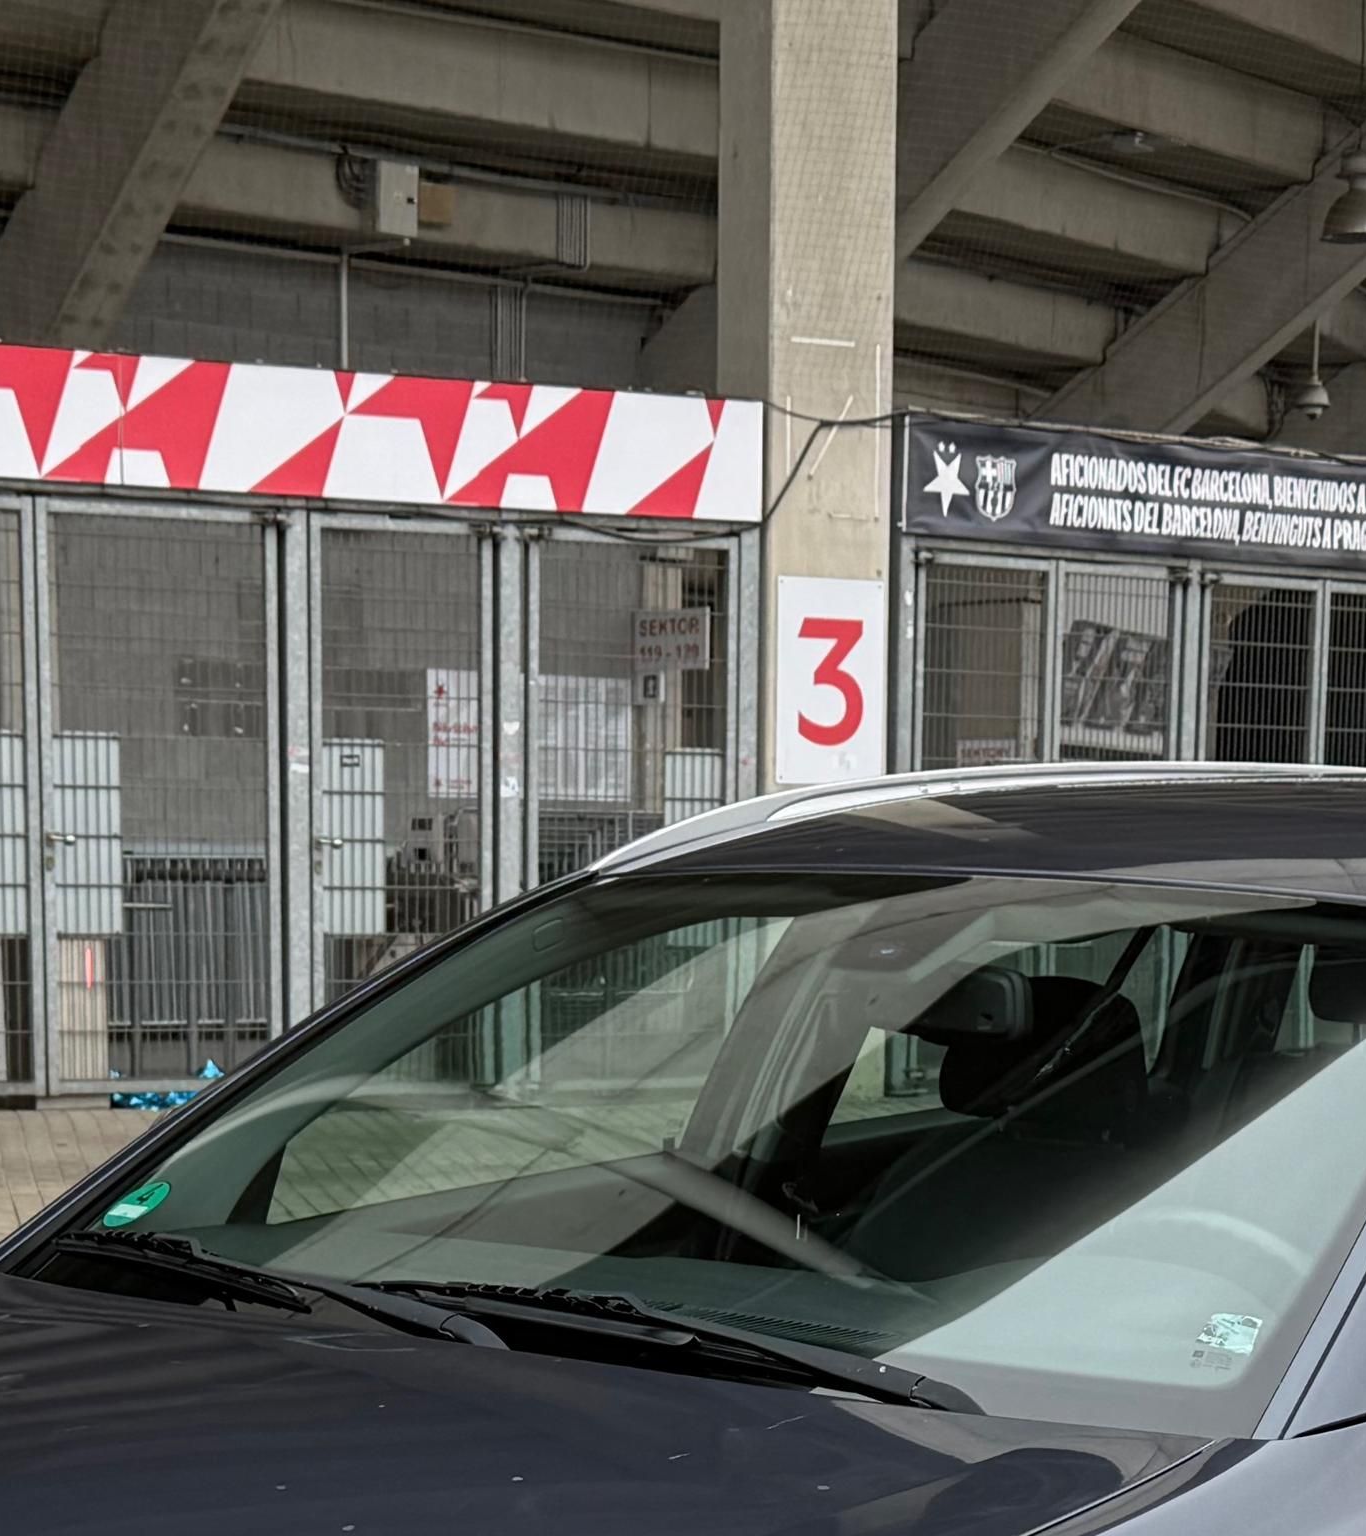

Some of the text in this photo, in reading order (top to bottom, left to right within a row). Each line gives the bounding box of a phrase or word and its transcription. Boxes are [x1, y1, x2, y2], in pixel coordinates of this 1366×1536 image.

[1050, 452, 1147, 494] AFICIONADOS
[1147, 463, 1172, 497] DEL
[1173, 465, 1191, 499] FC
[1191, 467, 1273, 510] BARCELONA,
[1273, 475, 1356, 514] BIENVENIDOS
[1356, 483, 1366, 514] A
[1049, 492, 1132, 532] AFICIONATS
[1133, 501, 1160, 534] DEL
[1161, 503, 1241, 547] BARCELONA,
[1242, 510, 1322, 549] BENVINGUTS
[1322, 518, 1332, 549] A
[797, 617, 863, 747] 3
